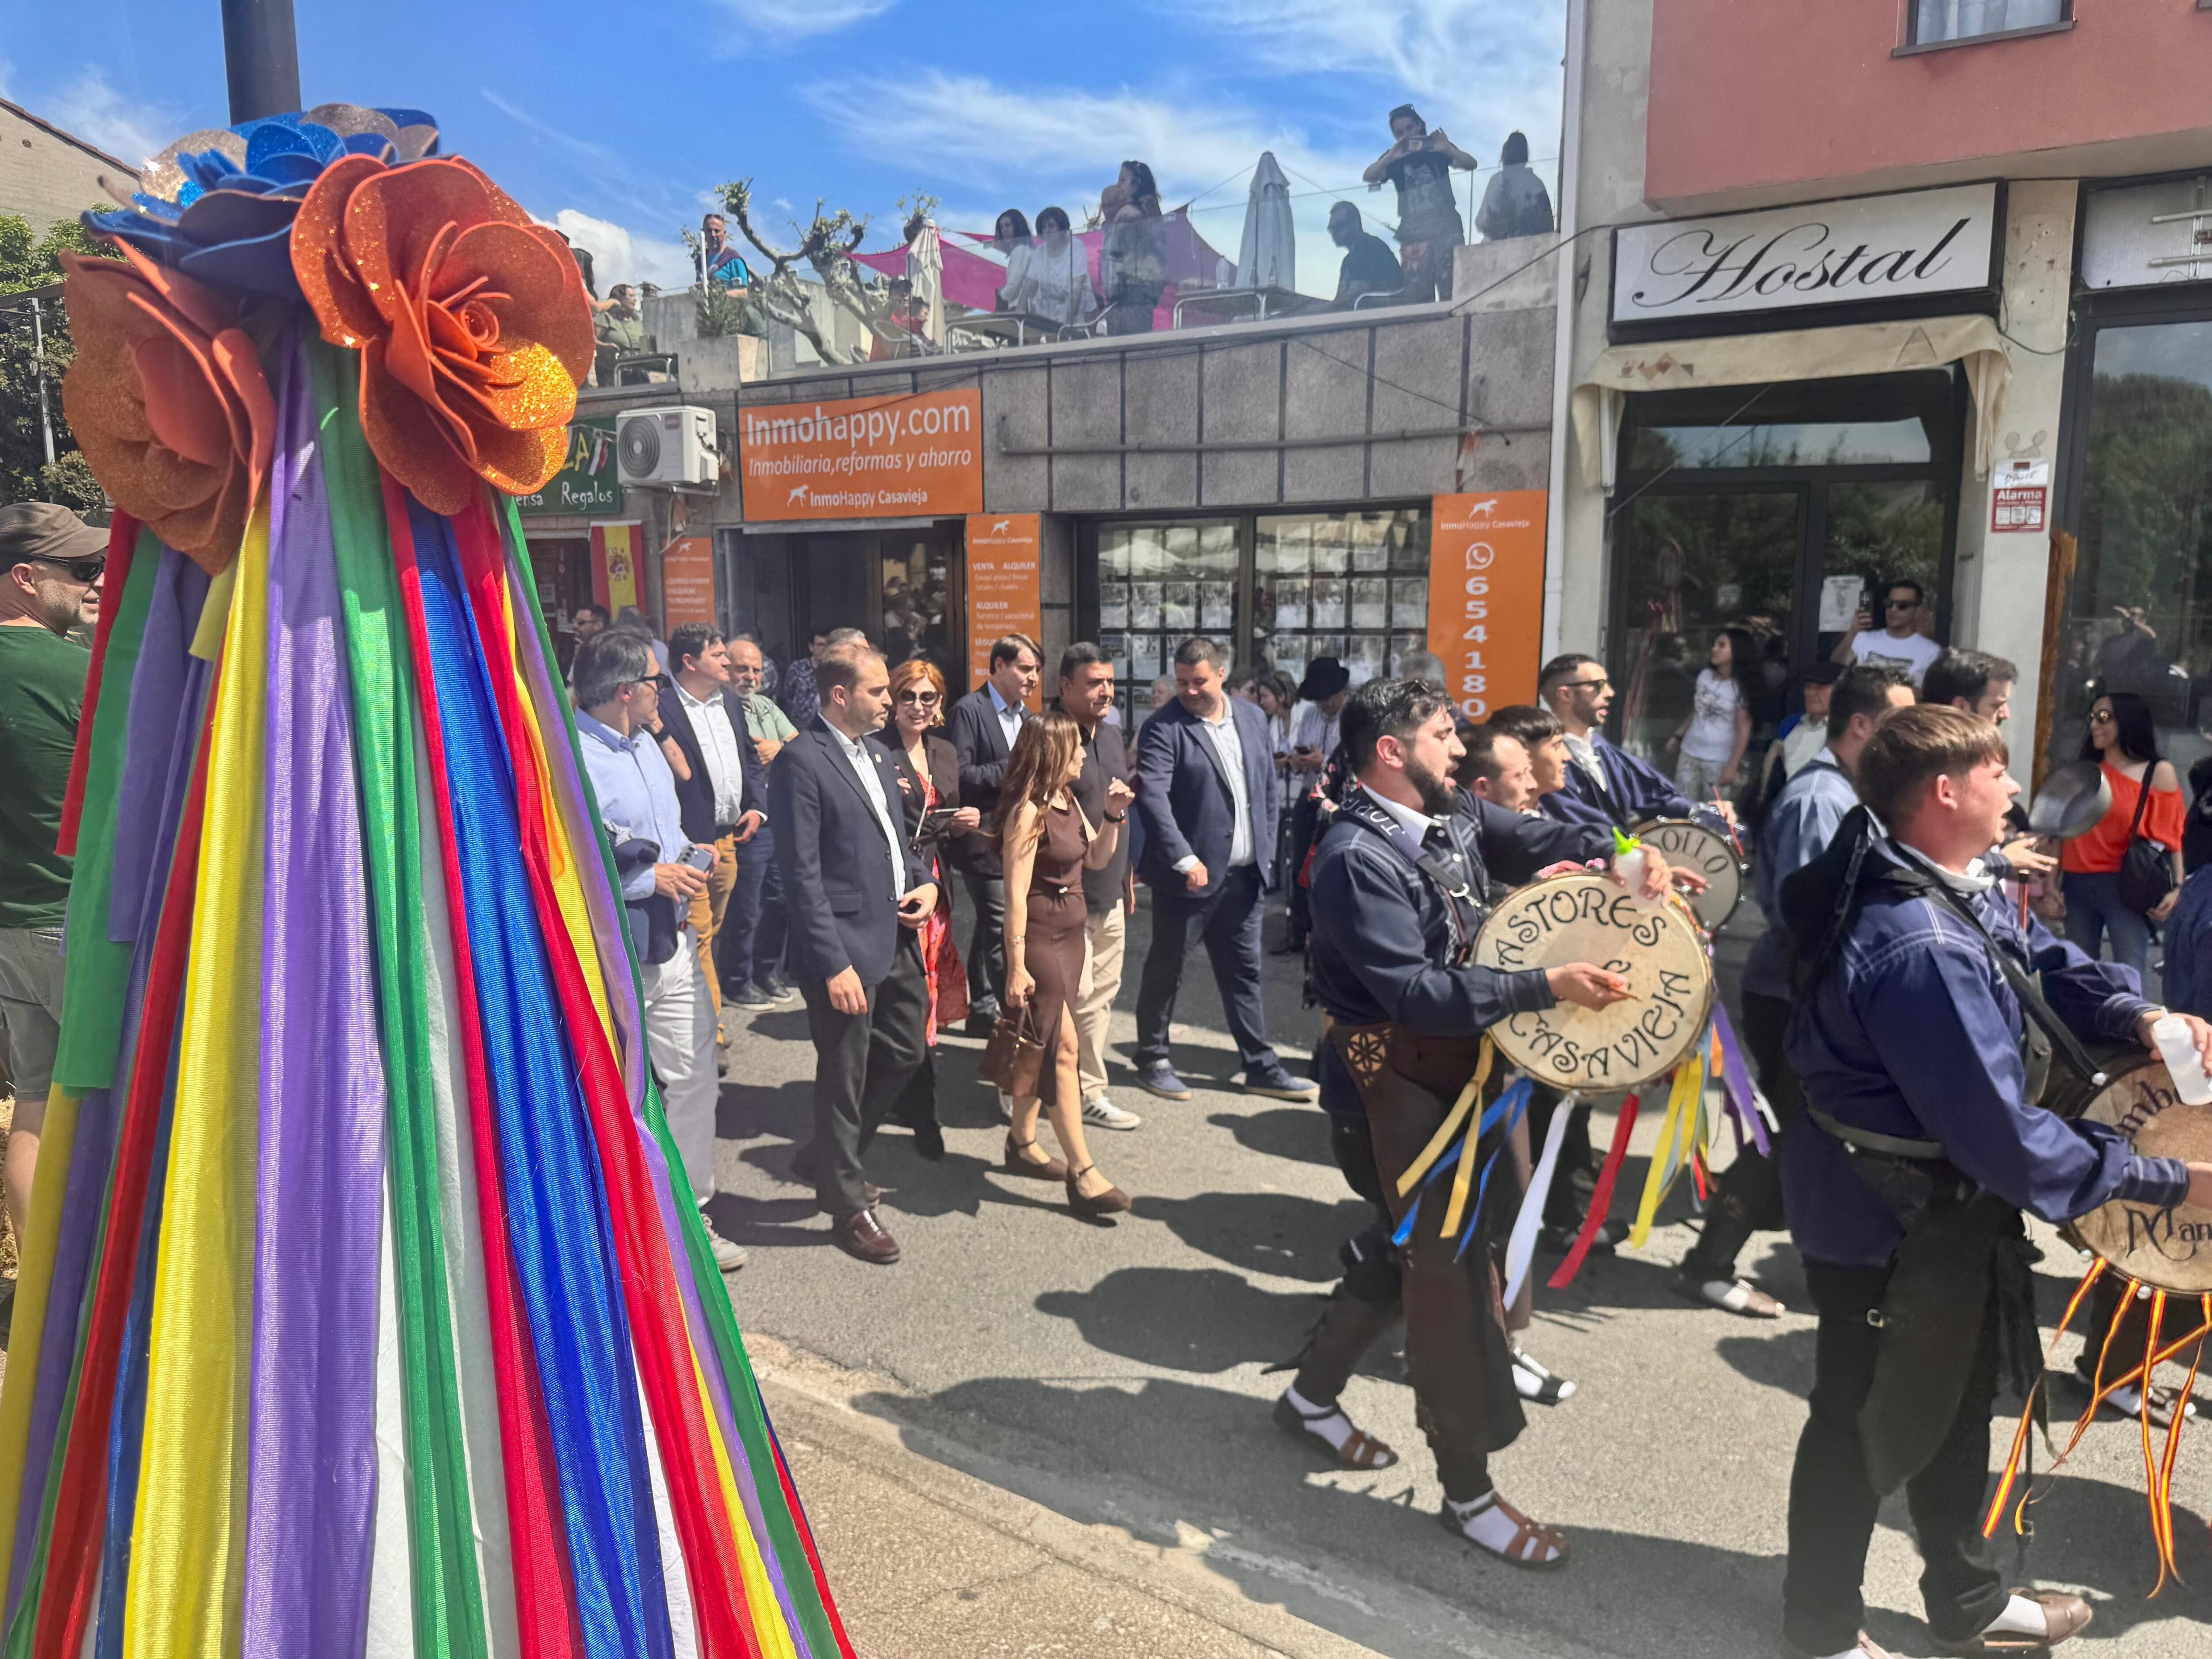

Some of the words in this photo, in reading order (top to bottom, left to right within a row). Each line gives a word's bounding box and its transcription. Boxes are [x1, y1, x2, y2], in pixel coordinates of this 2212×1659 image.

[1632, 217, 1971, 308] Hostal
[748, 405, 970, 448] Inmohappy.com
[905, 453, 915, 473] y
[918, 446, 972, 468] ahorro
[561, 481, 613, 511] Regalos
[810, 491, 875, 509] InmoHappy
[878, 488, 927, 506] Casavieja
[1997, 489, 2043, 500] Alarma
[972, 562, 995, 571] VENTA
[1002, 561, 1036, 571] ALQUILER
[975, 601, 1008, 610] ALQUILER
[1496, 887, 1667, 967] ASTORES
[1509, 970, 1691, 1079] CASAVIEJA
